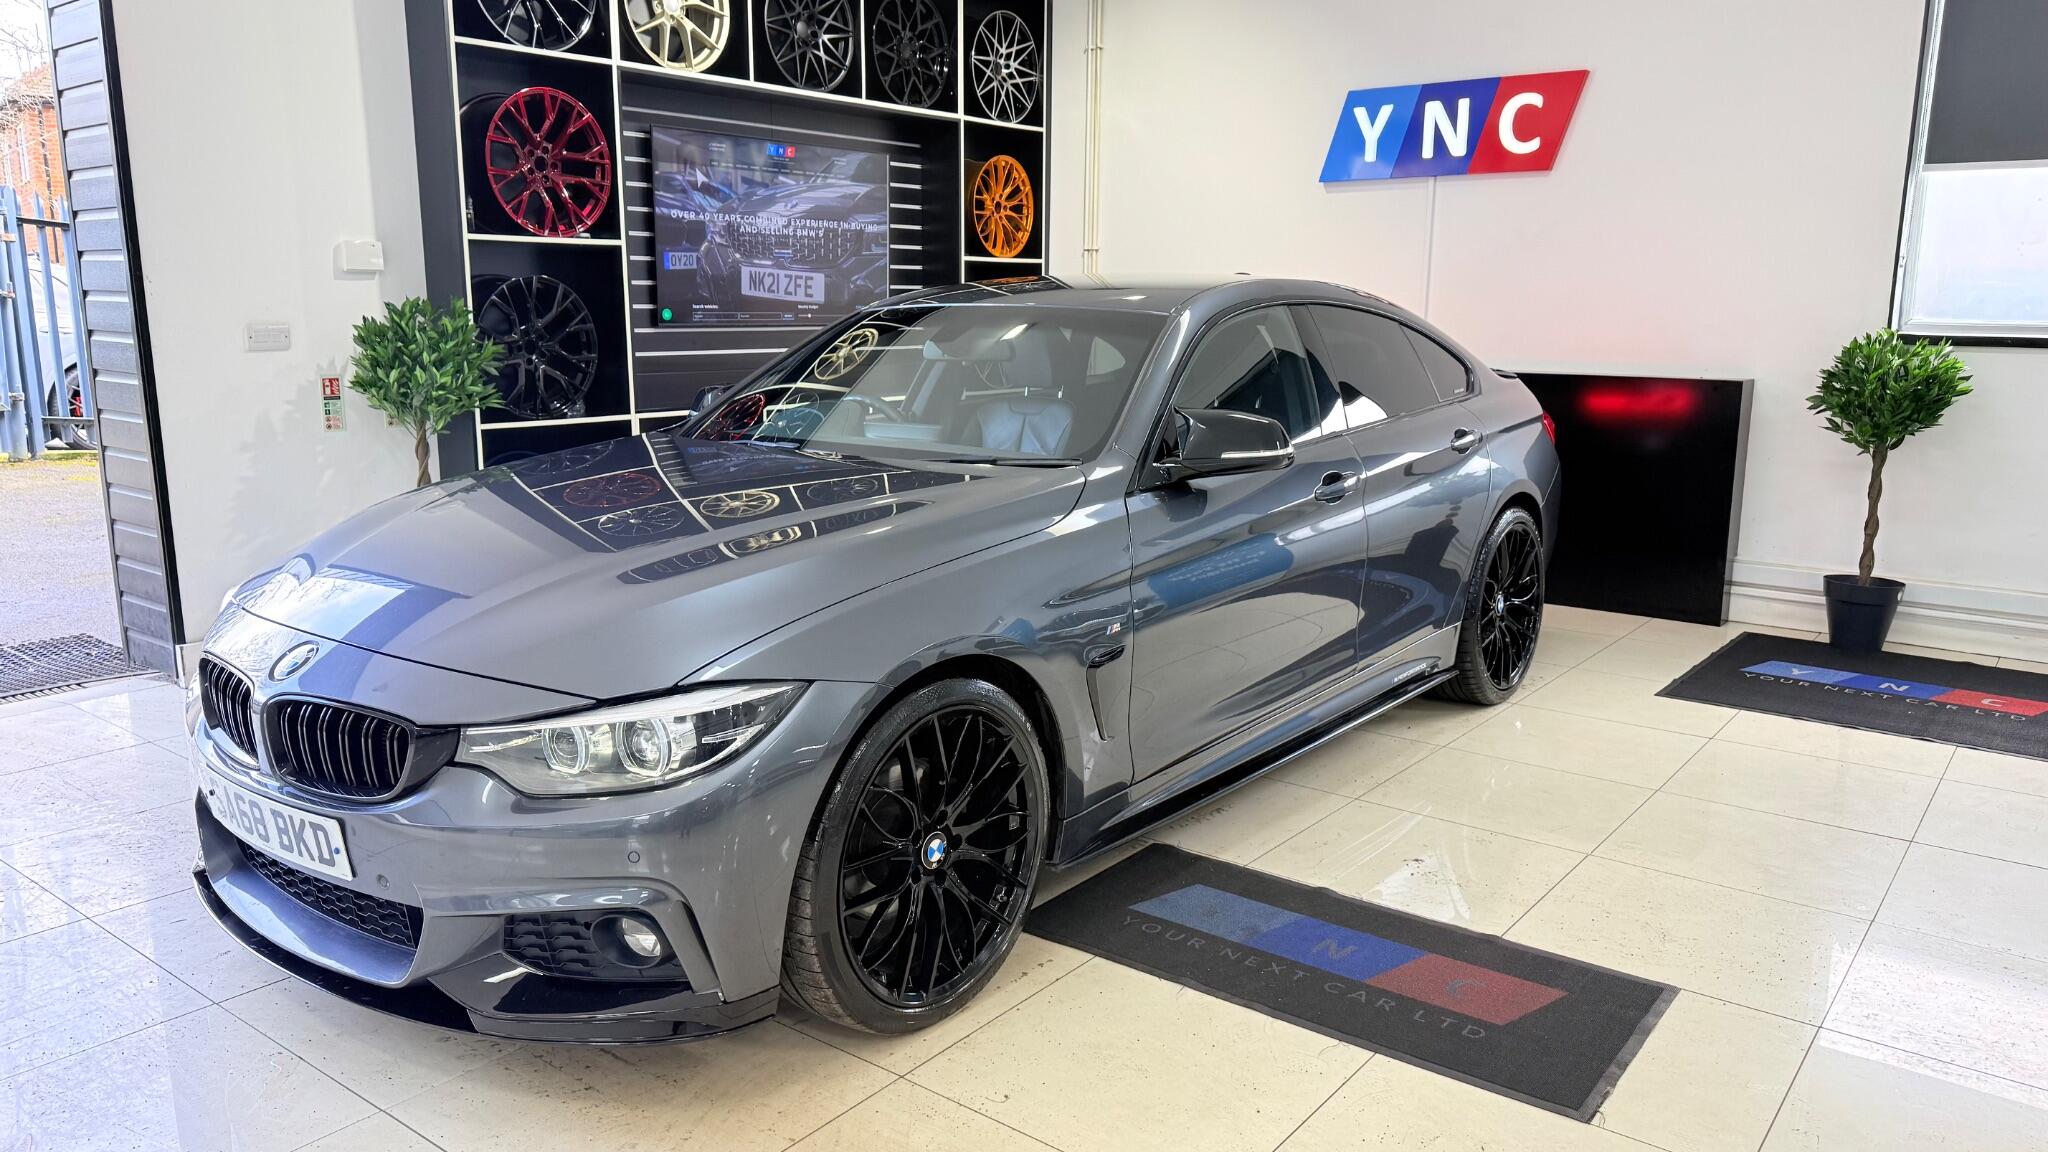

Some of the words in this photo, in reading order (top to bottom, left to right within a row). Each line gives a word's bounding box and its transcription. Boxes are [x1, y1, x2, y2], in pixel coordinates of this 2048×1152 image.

[1353, 92, 1544, 162] YNC
[670, 210, 696, 219] OVER
[699, 212, 710, 220] 40
[744, 215, 788, 225] COMBINED
[790, 218, 839, 229] EXPERIENCE
[840, 220, 849, 230] IN
[851, 222, 879, 232] BUYING
[739, 226, 758, 234] AND
[760, 227, 794, 236] SELLING
[670, 252, 694, 267] OY20
[749, 270, 780, 294] NK21
[783, 274, 815, 298] ZFE
[1743, 672, 1811, 687] YOUR
[1823, 685, 1893, 699] NEXT
[1905, 698, 1960, 710] CAR
[1975, 709, 2026, 721] LTD
[269, 807, 336, 868] BKD
[1122, 915, 1206, 949] YOUR
[1219, 947, 1310, 980] NEXT
[1324, 982, 1396, 1011] CAR
[1413, 1009, 1486, 1039] LTD
